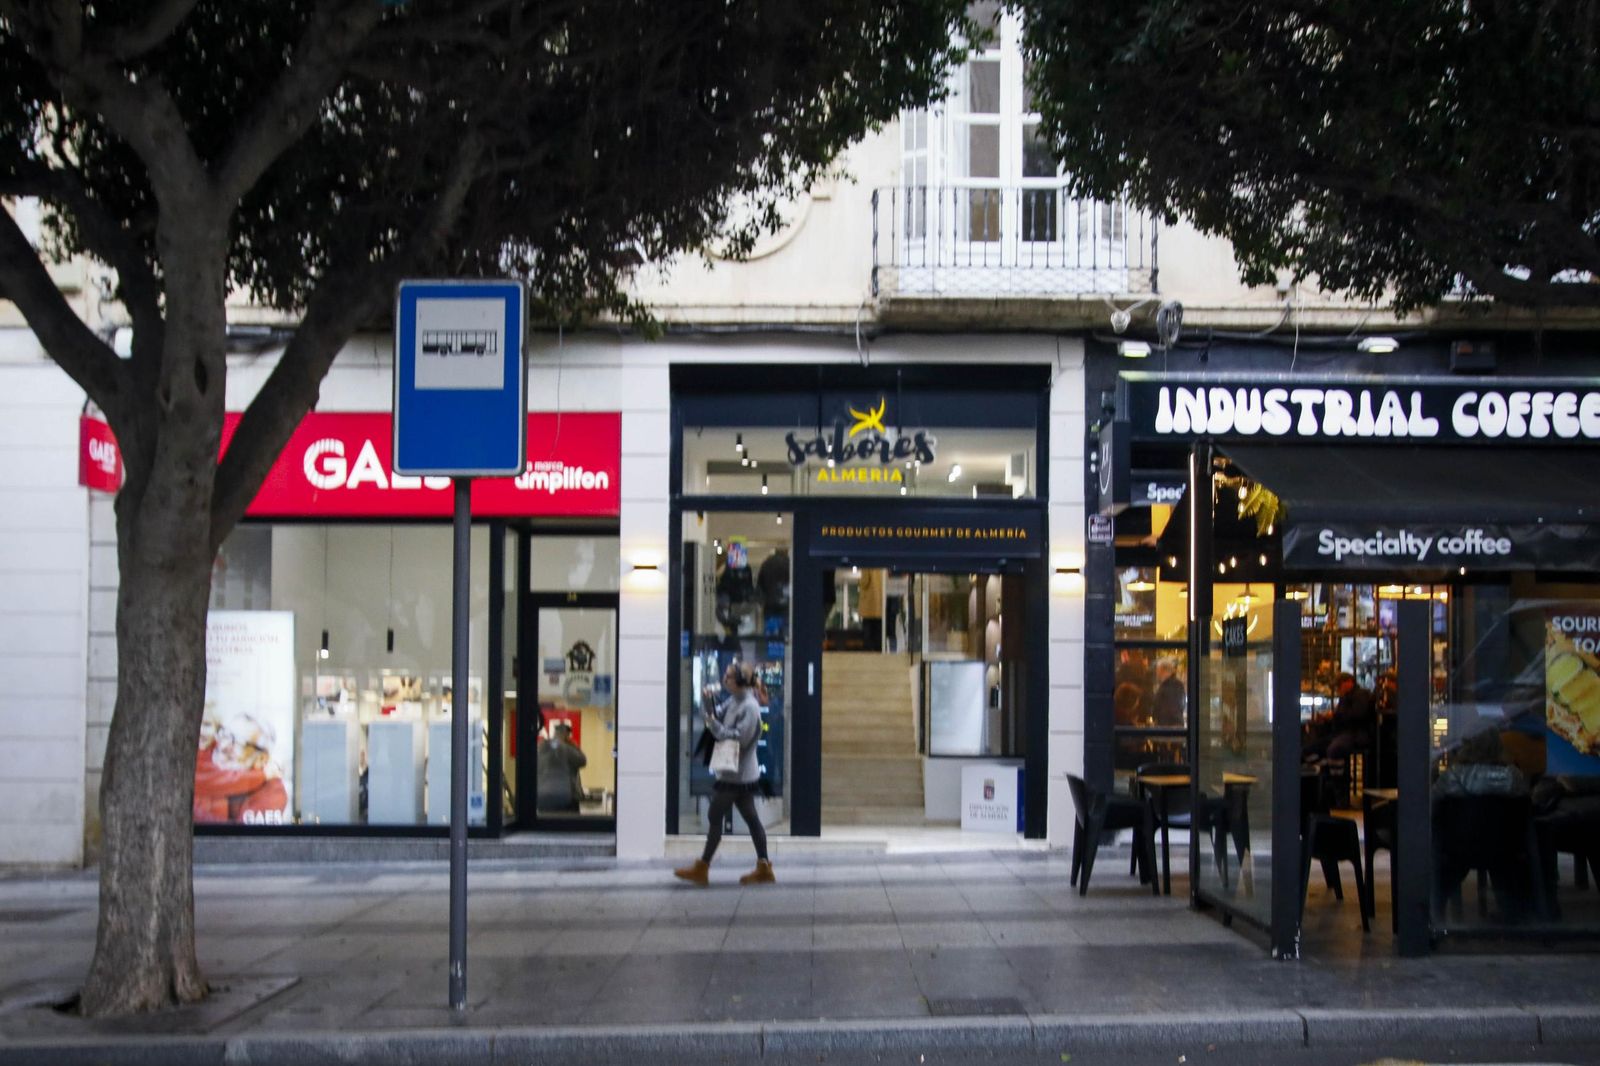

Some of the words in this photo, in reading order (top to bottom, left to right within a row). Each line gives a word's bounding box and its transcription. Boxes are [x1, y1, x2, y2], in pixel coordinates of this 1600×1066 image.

[1155, 386, 1439, 437] INDUSTRIAL
[1452, 391, 1600, 438] COFFEE
[784, 416, 936, 466] sabores
[821, 526, 893, 538] PRODUCTOS
[896, 527, 953, 539] GOURMET
[956, 528, 971, 539] DE
[974, 526, 1027, 539] ALMERÍA
[1318, 529, 1433, 560] Specialty
[1437, 529, 1512, 556] coffee
[1224, 625, 1245, 647] CAKES
[1552, 616, 1600, 632] SOUR
